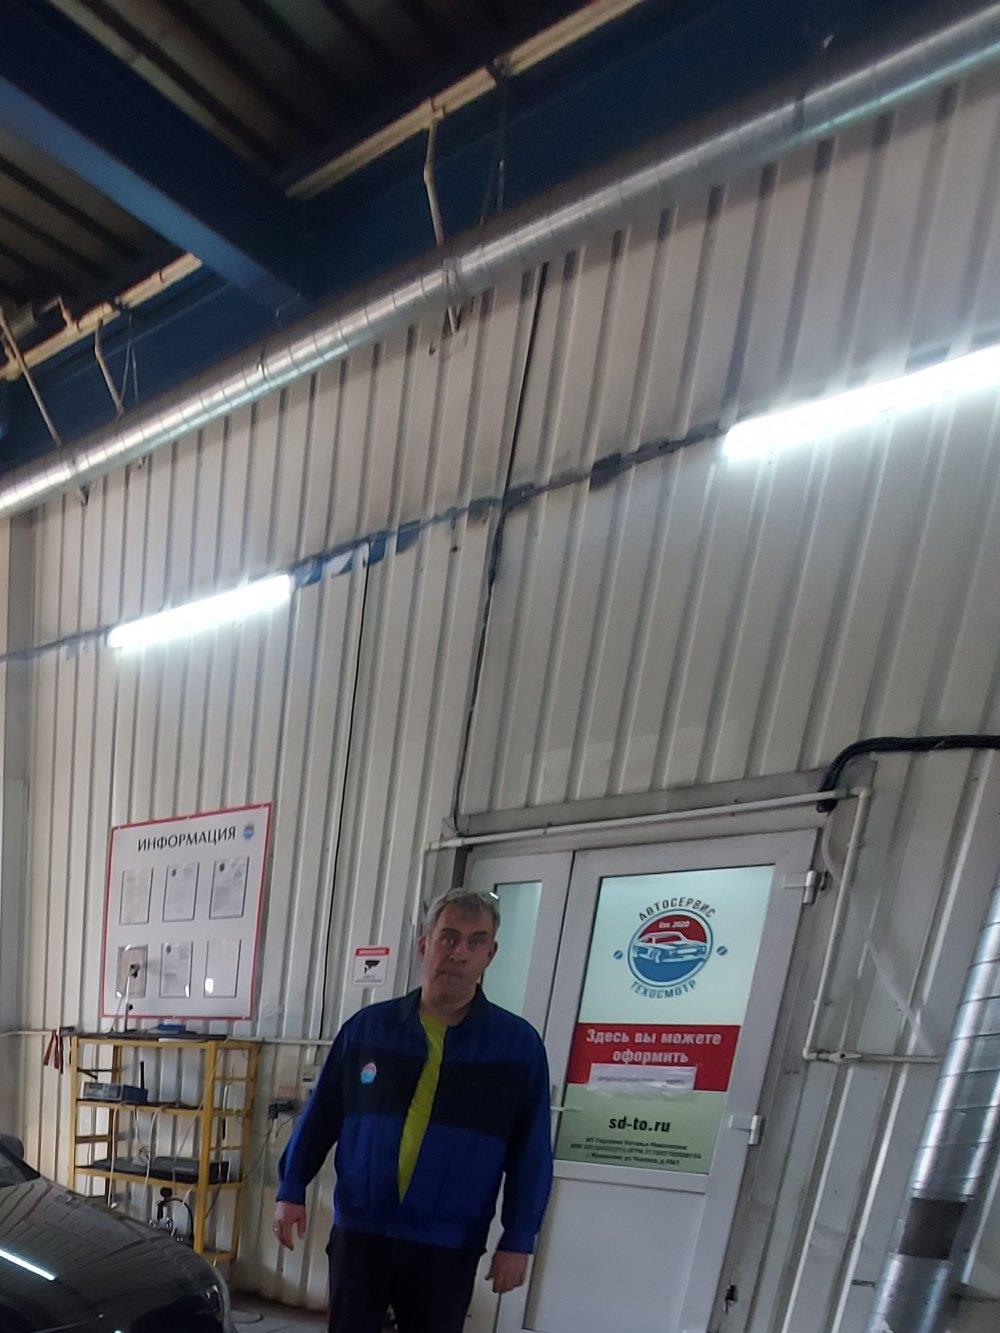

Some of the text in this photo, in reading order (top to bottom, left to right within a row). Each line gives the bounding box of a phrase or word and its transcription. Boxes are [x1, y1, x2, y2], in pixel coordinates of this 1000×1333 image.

[138, 826, 236, 851] ИНФОРМАЦИЯ
[639, 897, 716, 921] АВТОСЕРВИС
[630, 979, 697, 999] ТЕХОСМОТР
[586, 1028, 722, 1045] Здесь вы можете
[612, 1048, 689, 1066] оформить
[608, 1116, 671, 1132] sd-to.ru
